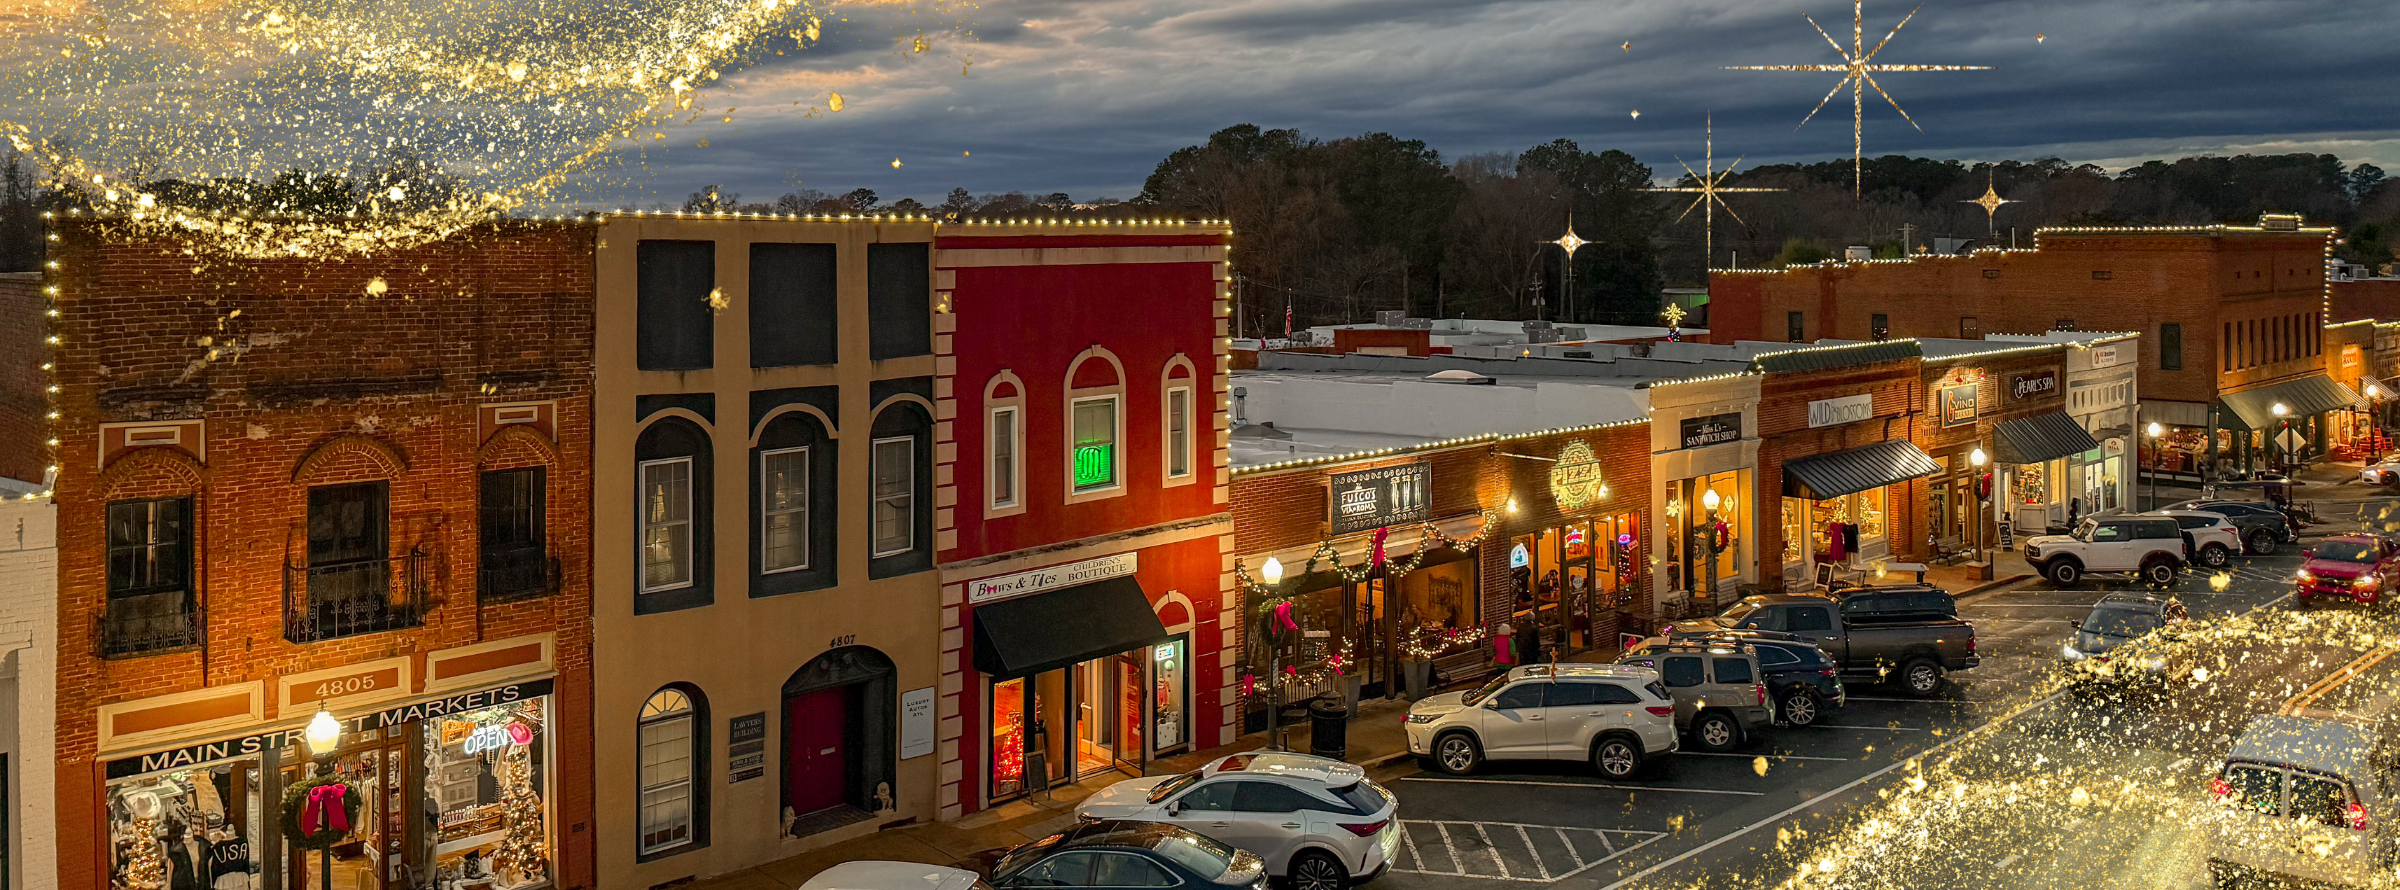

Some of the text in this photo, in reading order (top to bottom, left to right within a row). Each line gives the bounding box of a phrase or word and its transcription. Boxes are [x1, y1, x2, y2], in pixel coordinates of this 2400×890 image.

[2043, 376, 2054, 390] SPA
[1808, 402, 1830, 426] WILD
[1720, 430, 1737, 441] SHOP
[1550, 462, 1602, 486] PIZZA
[1341, 490, 1376, 505] FUSCO'S
[1067, 563, 1127, 582] BOUTIQUE
[1073, 556, 1121, 572] CHILDREN'S
[1015, 577, 1026, 589] &
[830, 634, 856, 648] 4807
[315, 674, 375, 697] 4805
[906, 698, 930, 707] LUXURY
[141, 685, 519, 773] MAIN STRET MARKETS
[464, 728, 508, 755] OPEN
[213, 842, 248, 864] USA
